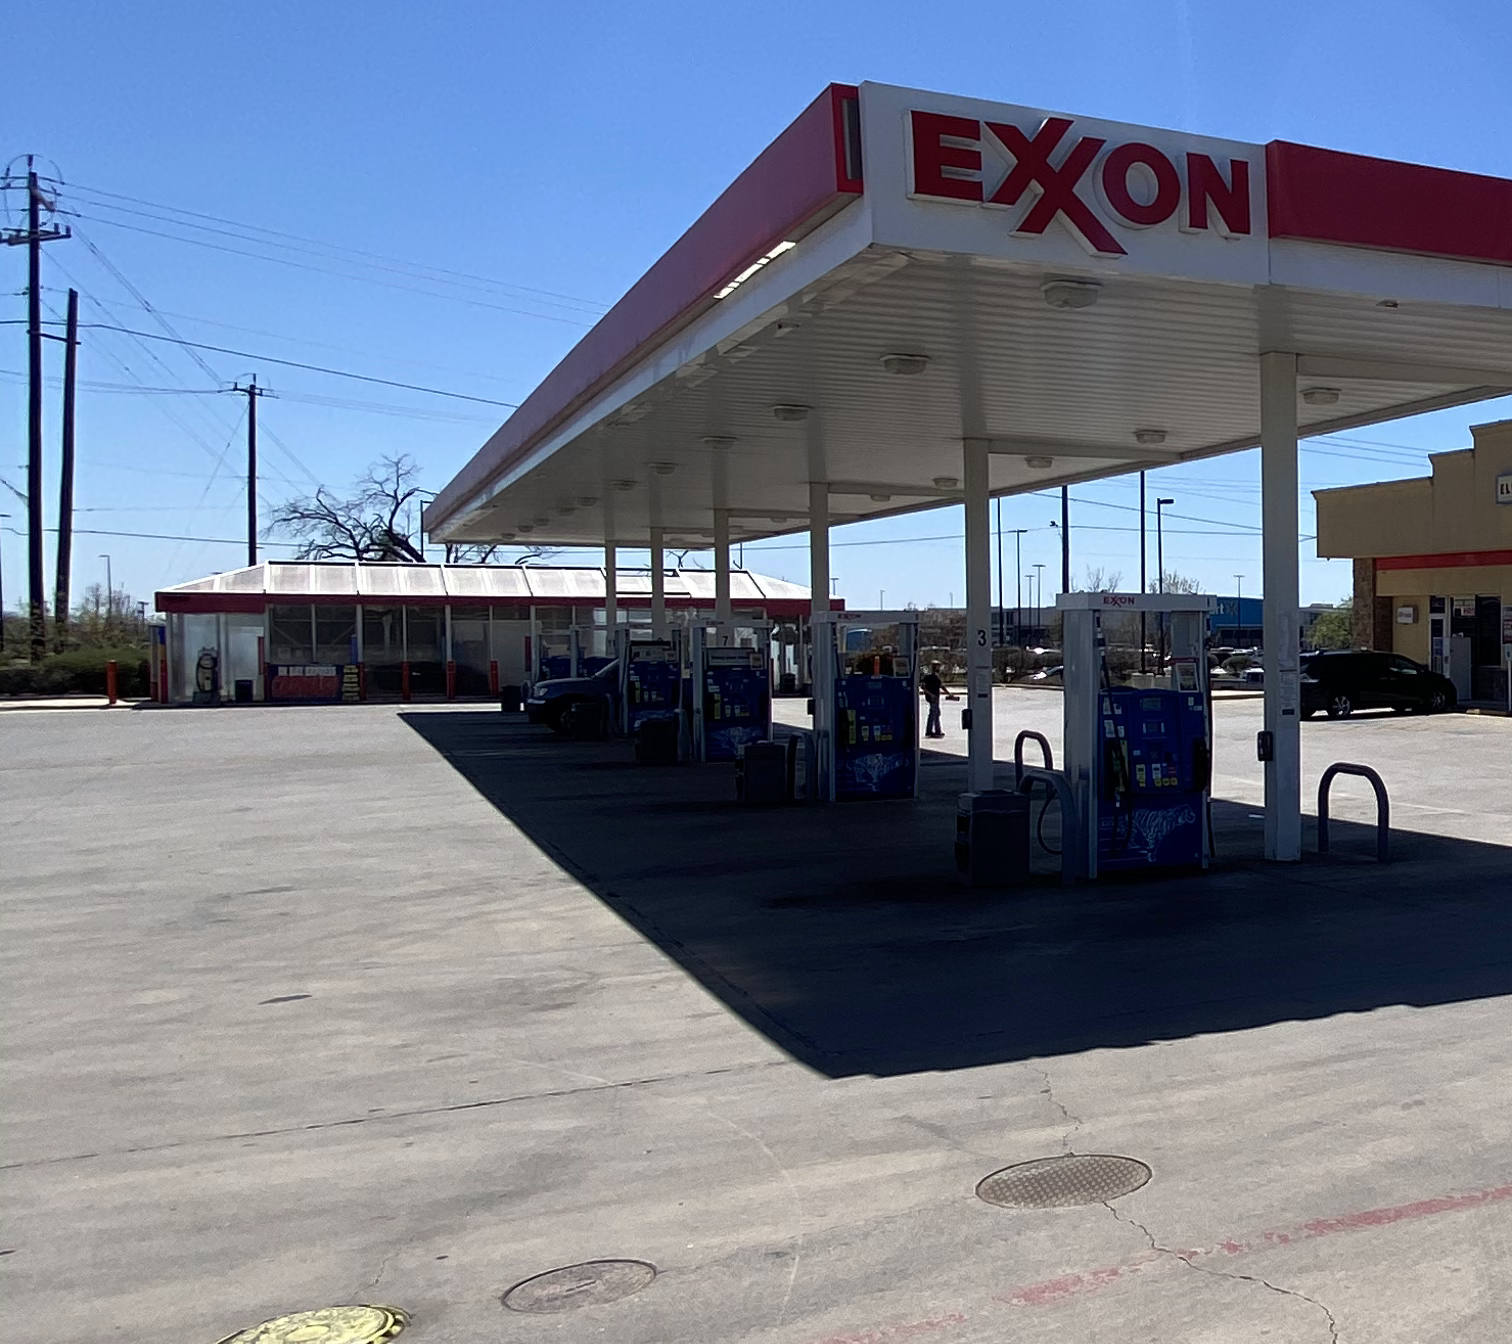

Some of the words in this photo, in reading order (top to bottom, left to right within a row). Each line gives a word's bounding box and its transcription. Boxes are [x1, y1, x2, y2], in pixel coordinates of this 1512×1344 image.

[910, 110, 1251, 256] EXXON
[1103, 595, 1135, 607] EXXON
[723, 636, 729, 646] 7
[978, 629, 986, 647] 3
